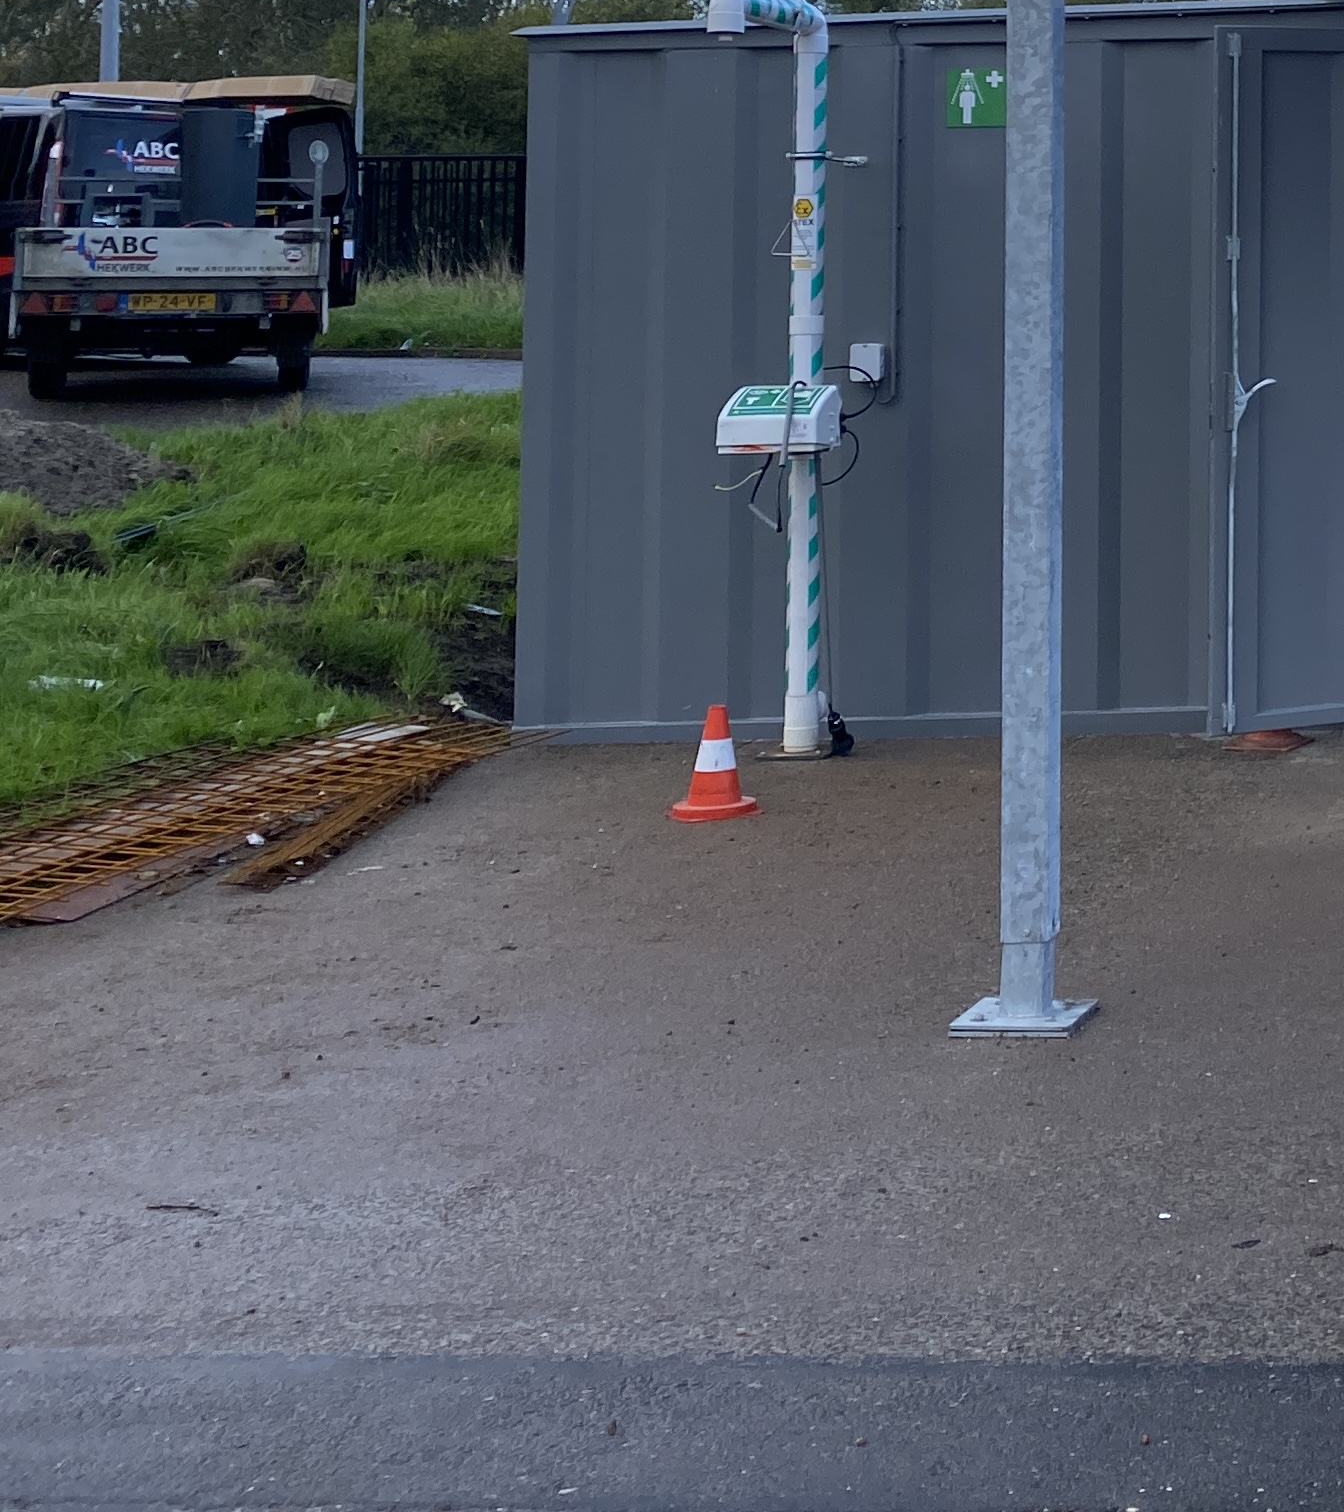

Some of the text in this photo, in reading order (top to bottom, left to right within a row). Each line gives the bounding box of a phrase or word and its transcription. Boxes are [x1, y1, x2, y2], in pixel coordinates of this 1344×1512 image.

[133, 141, 179, 159] ABC
[99, 236, 158, 254] ABC
[97, 263, 151, 272] HEKWERK
